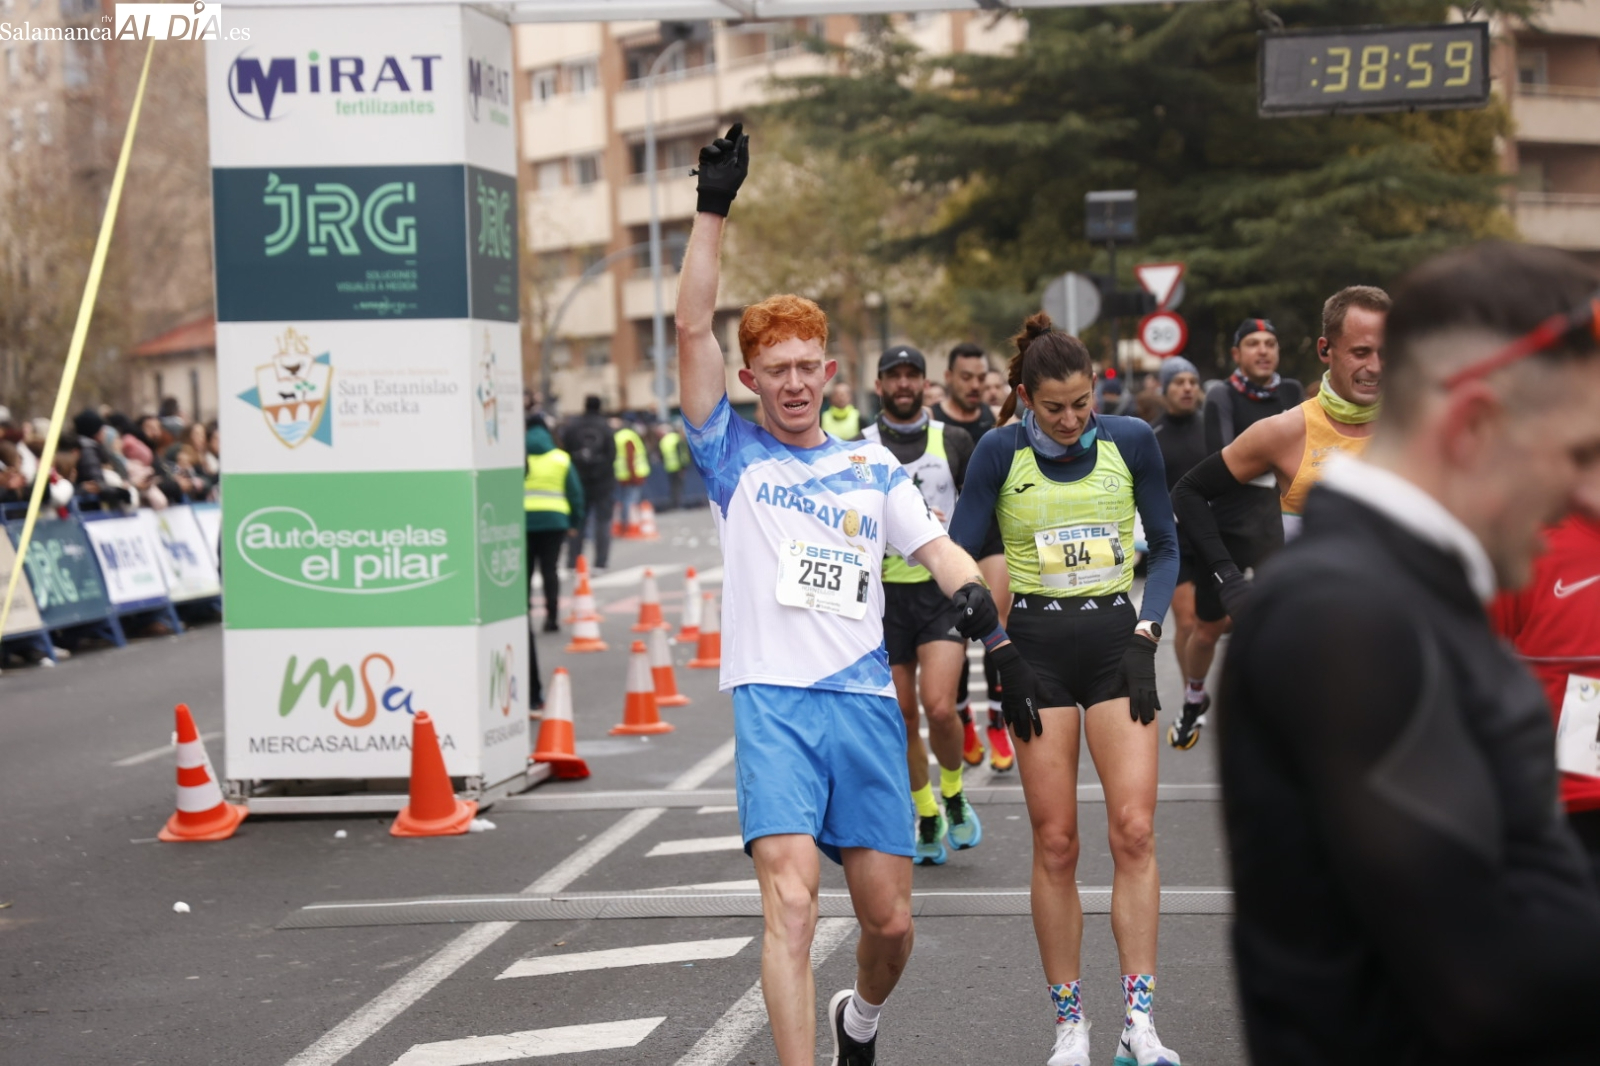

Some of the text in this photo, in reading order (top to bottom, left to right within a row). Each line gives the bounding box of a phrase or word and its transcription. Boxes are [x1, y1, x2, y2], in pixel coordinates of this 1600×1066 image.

[336, 98, 435, 116] fertilizantes
[338, 379, 459, 396] San Estanislao
[339, 398, 421, 415] de Kostka
[245, 522, 448, 550] autoescuelas
[1058, 527, 1111, 541] SETEL
[806, 546, 863, 567] SETEL
[1063, 541, 1091, 568] 84
[302, 546, 449, 589] el pilar
[798, 559, 842, 591] 253
[249, 733, 456, 754] MERCASALAMAA
